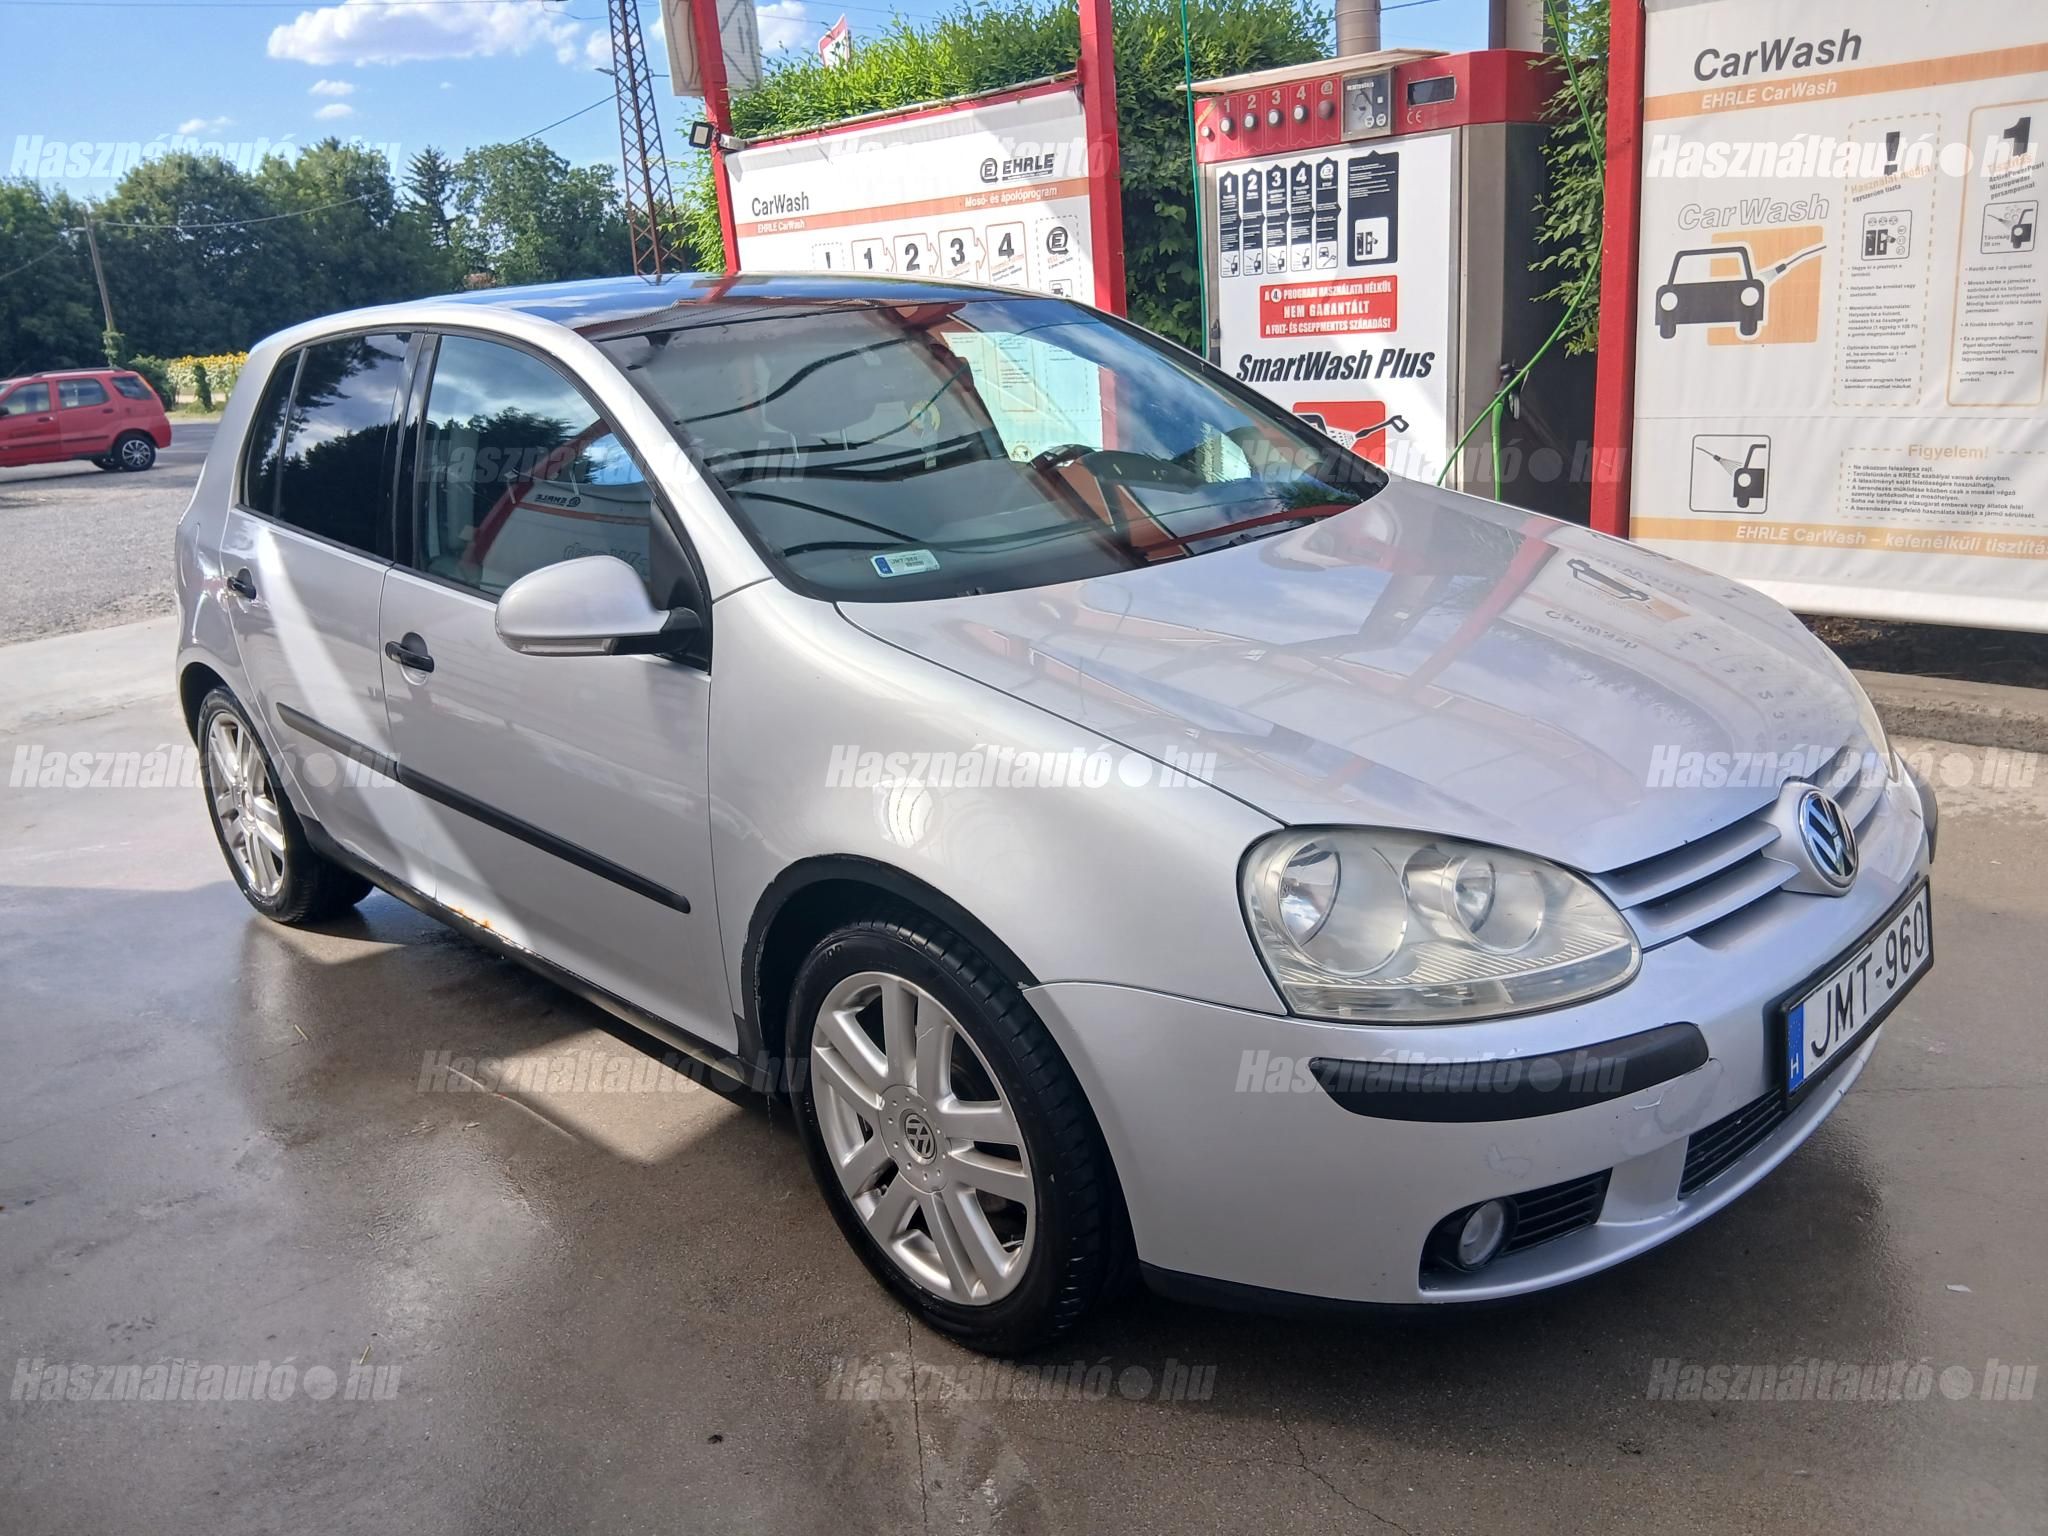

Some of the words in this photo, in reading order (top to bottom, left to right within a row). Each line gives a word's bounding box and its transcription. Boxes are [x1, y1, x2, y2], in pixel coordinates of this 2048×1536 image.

[1693, 28, 1862, 81] CarWash
[1247, 95, 1256, 109] 2
[1272, 90, 1281, 104] 3
[1297, 86, 1306, 100] 4
[1701, 87, 1756, 111] EHRLE
[1761, 79, 1838, 102] CarWash
[1003, 153, 1055, 175] EHRLE
[1224, 177, 1232, 193] 1
[1248, 174, 1257, 190] 2
[1272, 171, 1281, 187] 3
[1296, 167, 1307, 183] 4
[752, 191, 810, 217] CarWash
[1001, 187, 1058, 206] ápolóprogram
[1677, 193, 1831, 231] CarWash
[905, 243, 920, 271] 2
[950, 238, 965, 267] 3
[998, 232, 1015, 261] 4
[1283, 305, 1305, 319] NEM
[1309, 300, 1370, 317] GARANTÁLT
[1236, 349, 1373, 383] SmartWash
[1374, 347, 1435, 379] Plus
[1908, 443, 1989, 461] Figyelem!
[1735, 525, 1789, 541] EHRLE
[1793, 527, 1867, 546] CarWash
[1885, 530, 1982, 553] kefenélküli
[1810, 900, 1925, 1058] JMT-960
[1790, 1053, 1799, 1079] H
